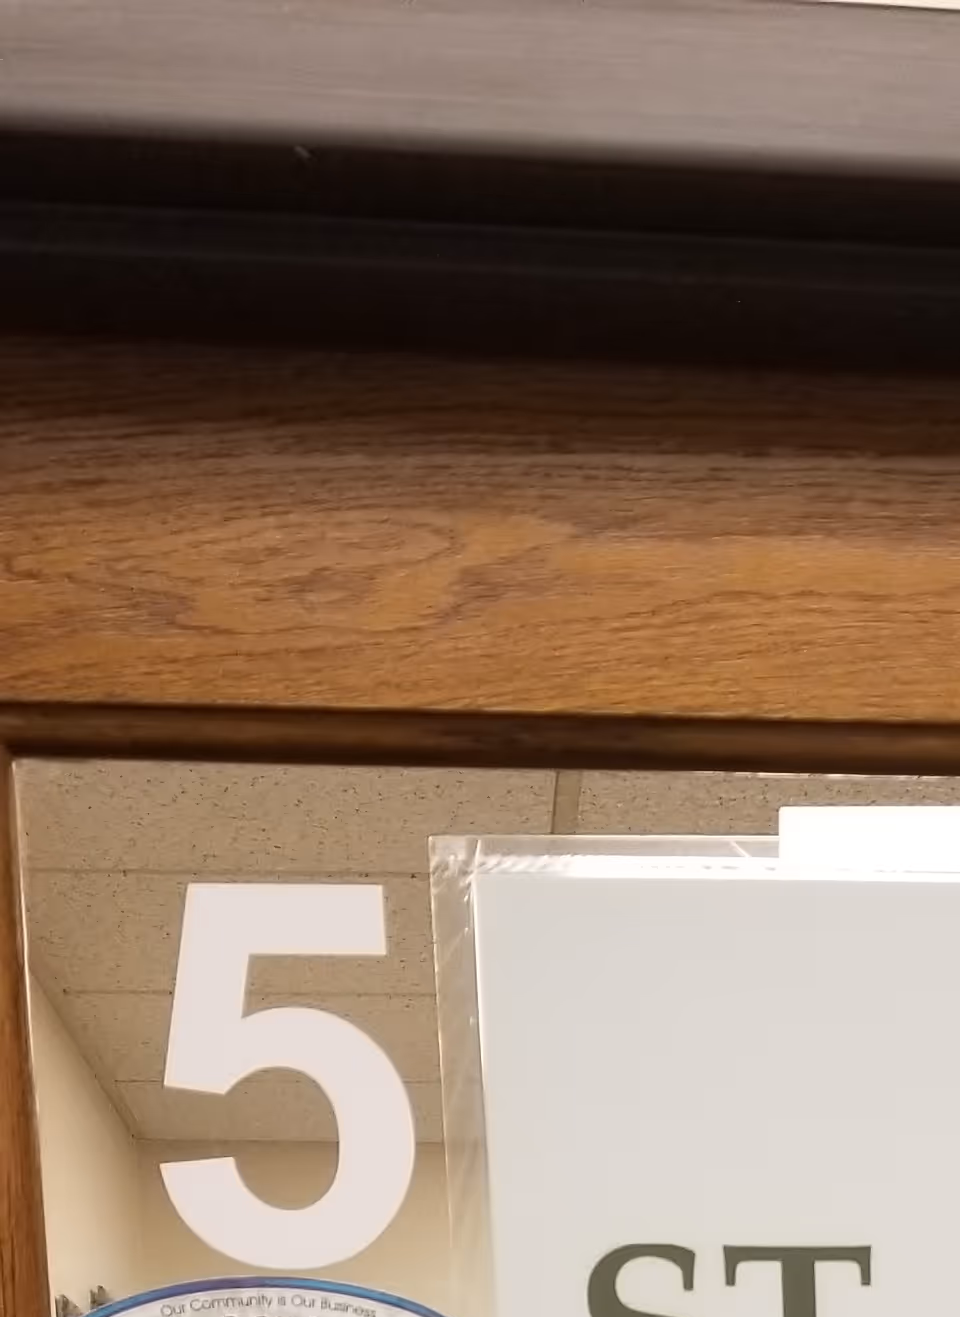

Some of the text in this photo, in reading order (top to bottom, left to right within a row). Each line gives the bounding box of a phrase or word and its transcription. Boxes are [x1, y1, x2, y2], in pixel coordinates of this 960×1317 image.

[160, 883, 415, 1270] 5
[160, 1304, 186, 1317] Our
[190, 1294, 273, 1313] Community
[277, 1296, 286, 1306] is
[291, 1295, 315, 1308] Our
